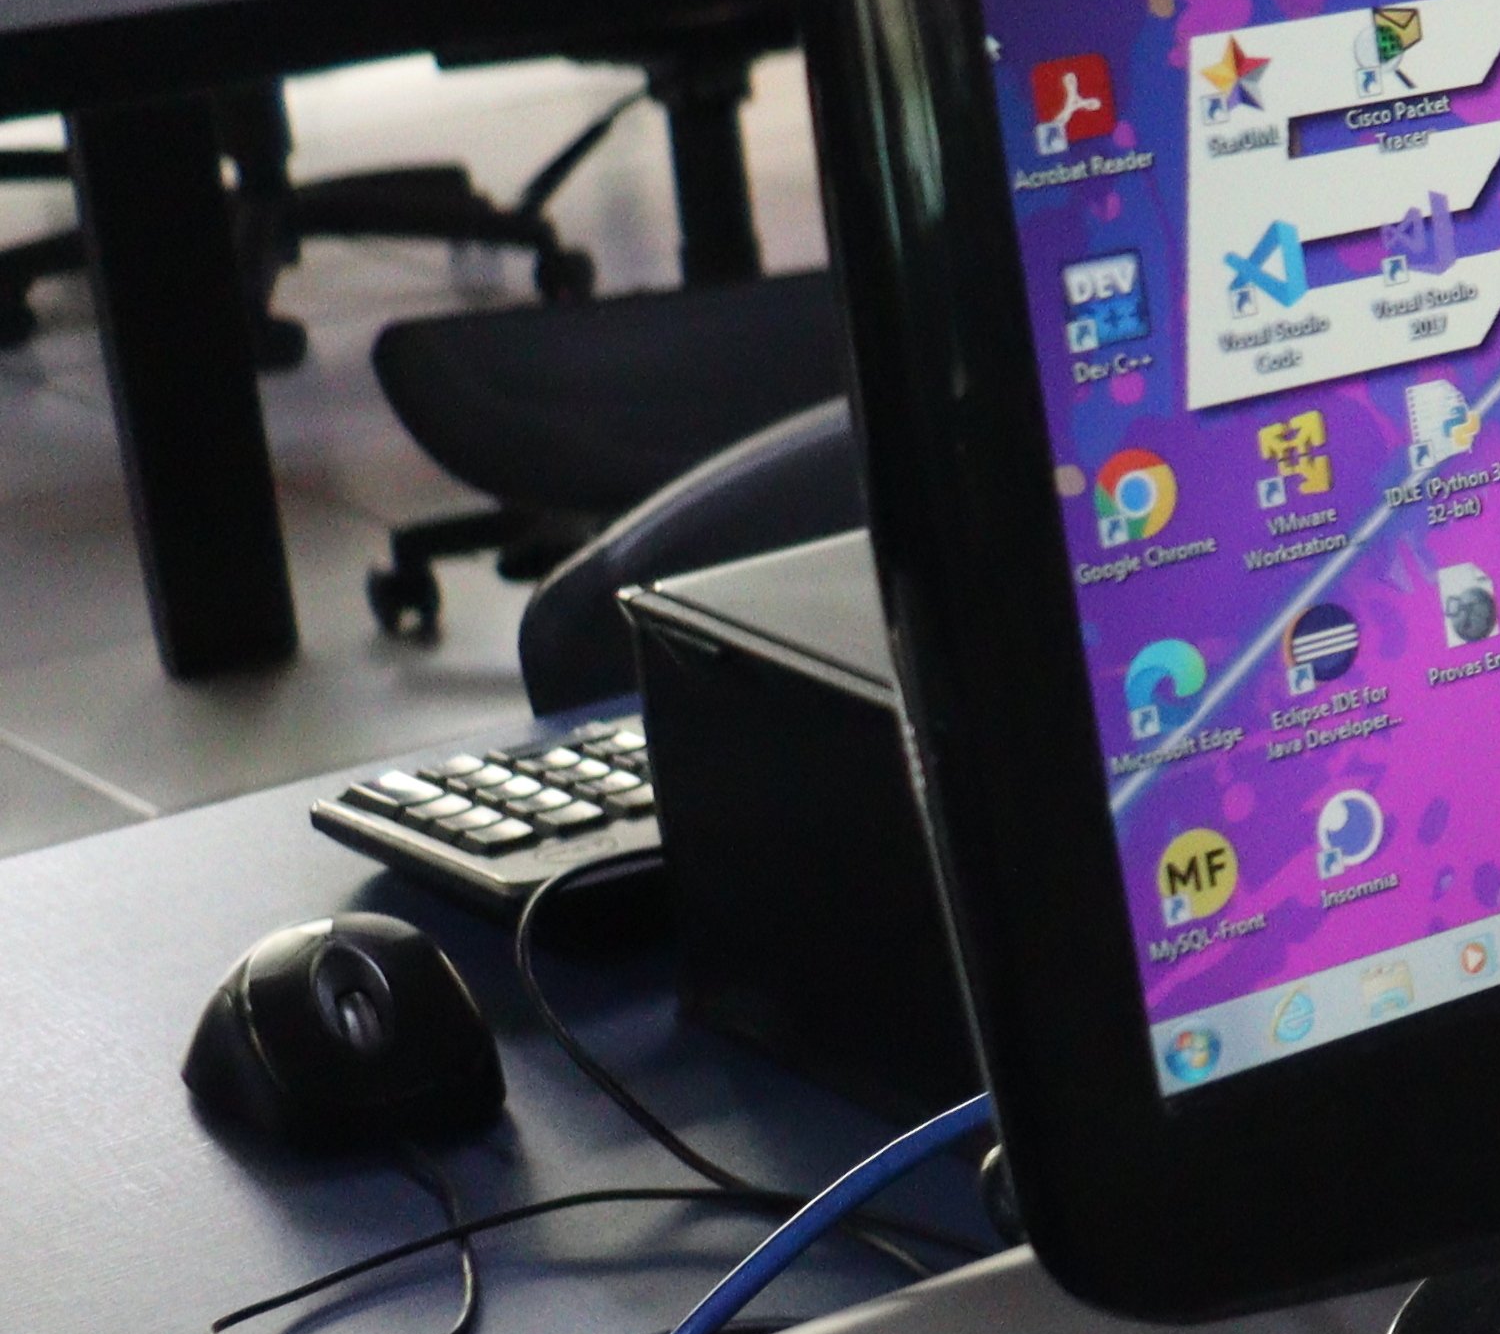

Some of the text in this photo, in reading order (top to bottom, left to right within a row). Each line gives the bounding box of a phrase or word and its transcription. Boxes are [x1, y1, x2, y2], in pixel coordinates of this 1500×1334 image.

[1346, 95, 1451, 131] Cisco Packet
[1375, 129, 1430, 154] Tracer
[1014, 151, 1155, 193] Acrobat Reader
[1066, 261, 1136, 307] DEV
[1426, 468, 1490, 501] (Python
[1426, 497, 1483, 527] 32-bit)
[1074, 535, 1217, 587] Google Chrome
[1427, 655, 1481, 686] Provas
[1270, 685, 1389, 733] Eclipse IDE for
[1110, 726, 1245, 775] Microsoft Edge
[1266, 736, 1304, 763] Java
[1320, 871, 1401, 910] Insomnia
[1148, 911, 1268, 965] MySQL-Front
